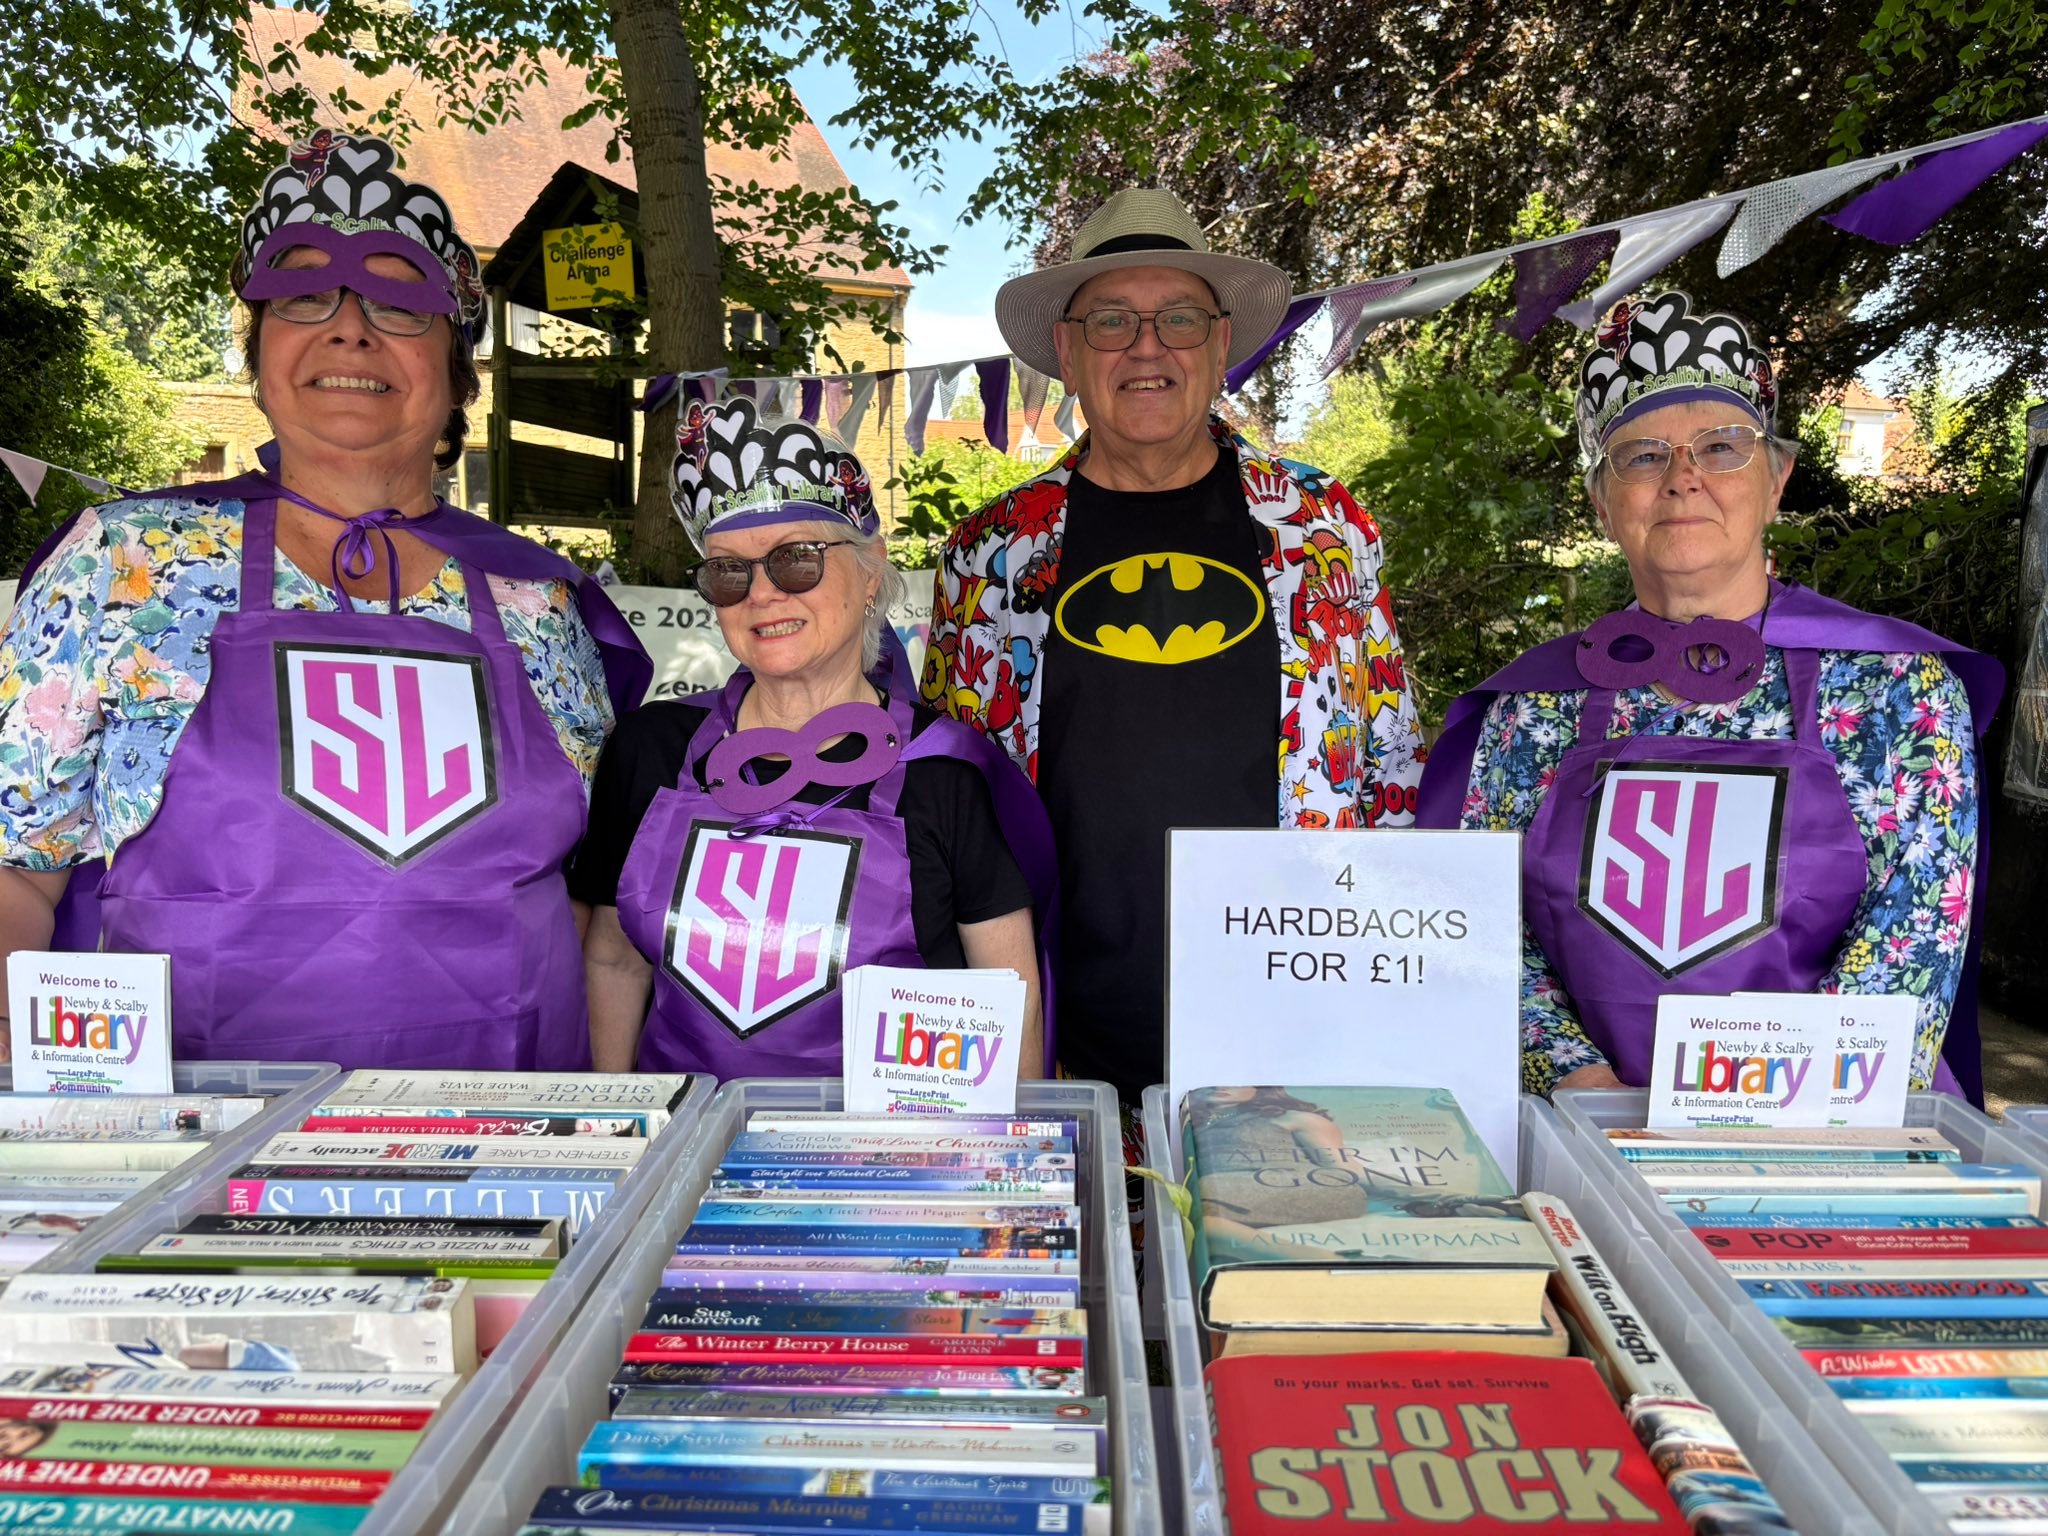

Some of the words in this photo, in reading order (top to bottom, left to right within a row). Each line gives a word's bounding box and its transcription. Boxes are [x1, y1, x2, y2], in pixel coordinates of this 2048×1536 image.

[550, 244, 625, 263] Callenge
[567, 264, 611, 280] Arna
[657, 606, 713, 630] 202
[903, 603, 933, 619] Sca
[1335, 864, 1356, 893] 4
[1224, 905, 1469, 941] HARDBACKS
[1266, 951, 1348, 984] FOR
[1370, 953, 1426, 986] £1!
[39, 973, 101, 989] Welcome
[104, 977, 118, 989] to
[64, 996, 100, 1012] Newby
[102, 998, 112, 1010] &
[115, 998, 149, 1015] Scalby
[891, 987, 957, 1006] Welcome
[961, 996, 976, 1009] to
[915, 1013, 953, 1031] Newby
[955, 1017, 966, 1030] &
[969, 1018, 1005, 1037] Scalby
[1689, 1016, 1762, 1032] Welcome
[1766, 1019, 1782, 1032] to
[1839, 1015, 1855, 1027] to
[30, 995, 148, 1065] Library
[874, 1010, 1004, 1087] Library
[1716, 1040, 1758, 1056] Newby
[1760, 1041, 1772, 1053] &
[1775, 1041, 1815, 1057] Scalby
[1835, 1037, 1847, 1049] &
[1849, 1036, 1888, 1051] Scalby
[31, 1050, 40, 1061] &
[42, 1050, 94, 1064] Information
[96, 1053, 127, 1065] Centre
[872, 1066, 882, 1079] &
[884, 1068, 940, 1085] Information
[942, 1073, 973, 1088] Centre
[1672, 1039, 1813, 1109] Library
[438, 1082, 484, 1090] DAVIS
[486, 1082, 530, 1090] WADE
[546, 1084, 655, 1093] SILENCE
[530, 1094, 582, 1103] THE
[585, 1094, 657, 1103] INTO
[1671, 1096, 1682, 1107] &
[1684, 1096, 1744, 1109] Information
[1745, 1097, 1780, 1109] Centre
[1829, 1096, 1854, 1105] entre
[472, 1118, 555, 1137] Brutal
[762, 1141, 852, 1150] Matthews
[780, 1133, 842, 1142] Carole
[935, 1137, 1031, 1149] Christmas
[308, 1144, 380, 1156] actually
[487, 1148, 552, 1159] CLARKE
[555, 1149, 631, 1160] STEPHEN
[1227, 1146, 1374, 1164] AFTER
[1389, 1145, 1460, 1163] I'M
[406, 1167, 469, 1177] antiques
[751, 1168, 804, 1180] Starlight
[876, 1169, 912, 1178] Castle
[1253, 1164, 1450, 1188] GONE
[1636, 1164, 1690, 1175] Gina
[1691, 1164, 1741, 1175] Ford
[868, 1207, 903, 1216] Place
[906, 1207, 919, 1216] in
[923, 1208, 968, 1218] Prague
[1539, 1206, 1573, 1249] Sharpe
[1558, 1215, 1581, 1241] Tom
[894, 1231, 963, 1242] Christmas
[1230, 1231, 1345, 1249] LAURA
[1362, 1231, 1521, 1248] LIPPMAN
[1749, 1232, 1833, 1249] POP
[1840, 1234, 1872, 1243] Truth
[1874, 1234, 1895, 1243] and
[1898, 1235, 1933, 1243] Power
[349, 1241, 408, 1250] ETHICS
[410, 1241, 436, 1250] OF
[438, 1242, 499, 1251] PUZZLE
[501, 1242, 532, 1251] THE
[720, 1259, 800, 1269] Christmas
[1723, 1262, 1769, 1272] WHY
[1775, 1261, 1844, 1272] MARS
[1803, 1279, 2029, 1297] FATHERHOOD
[694, 1306, 732, 1318] Sue
[1571, 1254, 1613, 1292] Wilt
[1593, 1291, 1619, 1312] on
[1608, 1313, 1661, 1365] High
[657, 1313, 763, 1327] Moorcroft
[655, 1335, 688, 1350] The
[696, 1335, 770, 1351] Winter
[773, 1336, 835, 1354] Berry
[840, 1337, 911, 1351] House
[929, 1338, 1007, 1347] CAROLINE
[943, 1346, 992, 1355] FLYNN
[1838, 1354, 1897, 1372] Whole
[1901, 1353, 1993, 1375] LOTTA
[1273, 1377, 1296, 1389] On
[1301, 1378, 1339, 1391] your
[1346, 1378, 1405, 1390] marks.
[1411, 1378, 1442, 1390] Get
[1483, 1377, 1551, 1390] Survive
[26, 1401, 90, 1419] WIG
[91, 1403, 152, 1421] THE
[154, 1406, 261, 1425] UNDER
[1334, 1402, 1520, 1451] JON
[607, 1430, 675, 1450] Daisy
[27, 1461, 95, 1485] THE
[97, 1463, 212, 1489] UNDER
[911, 1474, 979, 1490] Christmas
[987, 1475, 1029, 1495] Spirit
[1248, 1446, 1663, 1524] STOCK
[639, 1496, 760, 1513] Christmas
[766, 1497, 870, 1521] Morning
[74, 1503, 295, 1532] UNNATURAL
